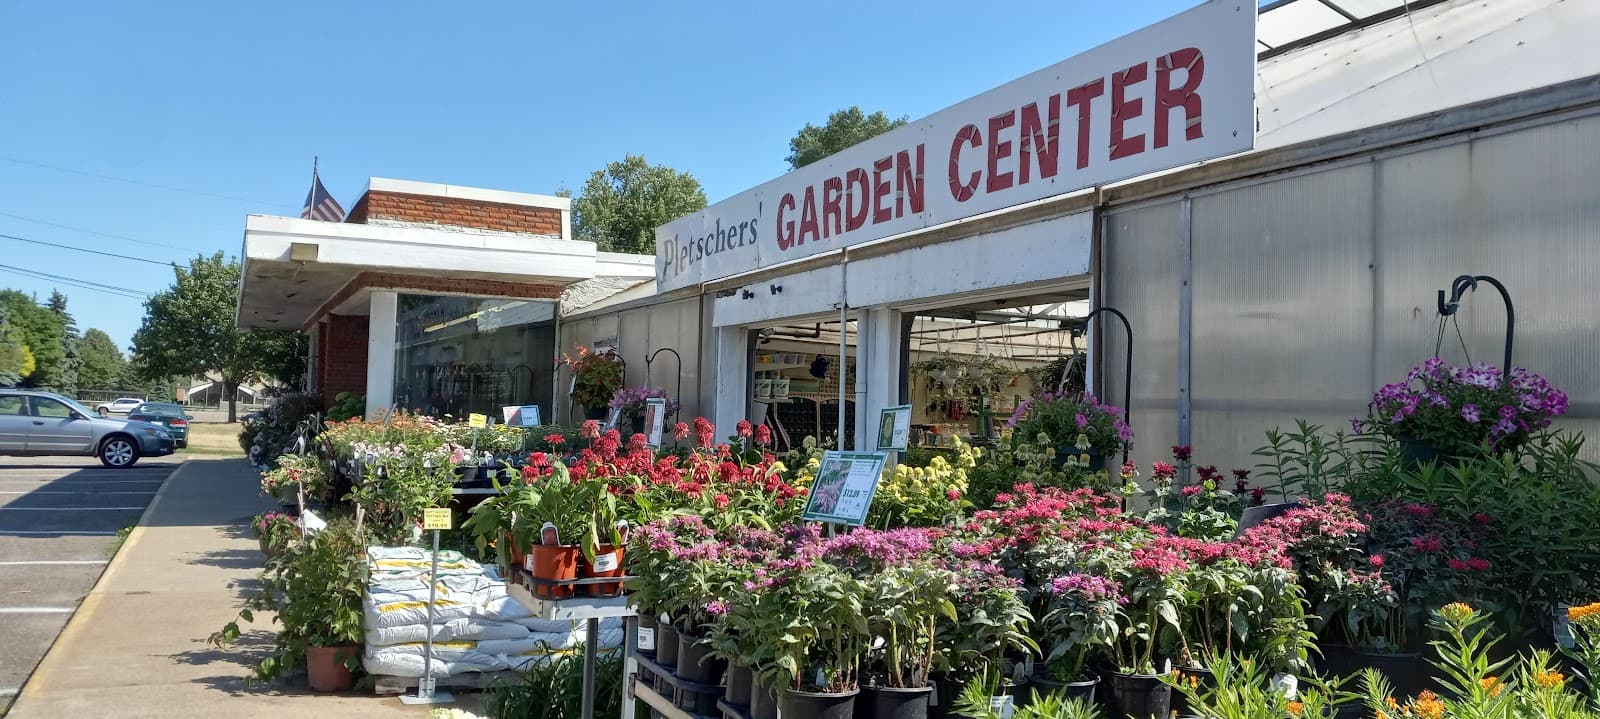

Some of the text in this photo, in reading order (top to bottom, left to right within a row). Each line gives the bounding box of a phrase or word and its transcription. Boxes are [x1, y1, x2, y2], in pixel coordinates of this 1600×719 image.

[661, 46, 1206, 283] Pletschers' GARDEN CENTER
